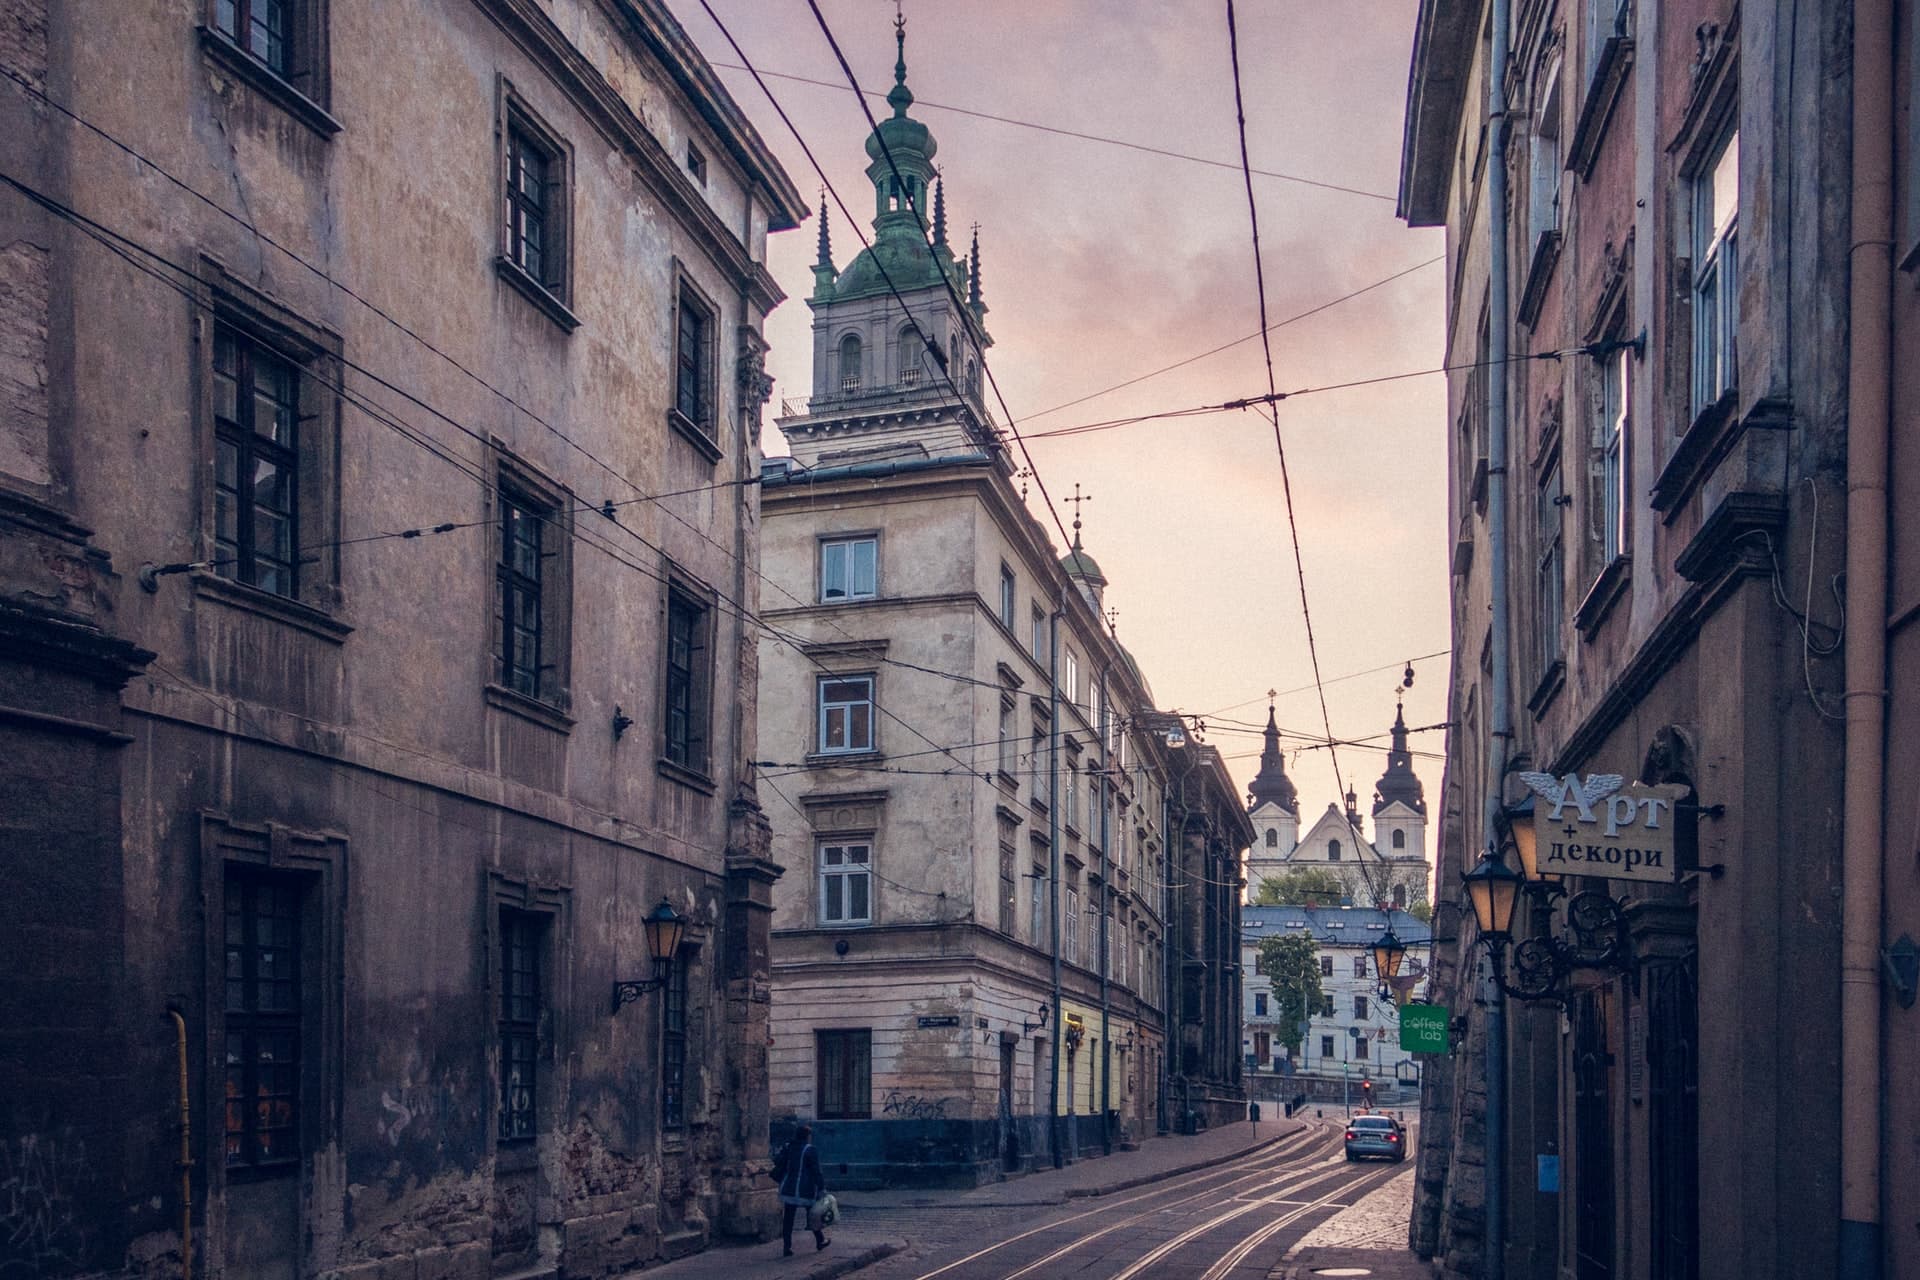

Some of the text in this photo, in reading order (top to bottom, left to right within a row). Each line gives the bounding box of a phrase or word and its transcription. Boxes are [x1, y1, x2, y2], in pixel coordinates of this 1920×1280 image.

[1547, 772, 1669, 839] Арт
[1547, 842, 1664, 873] декори
[1403, 1016, 1445, 1031] coffee
[1420, 1029, 1442, 1041] lab
